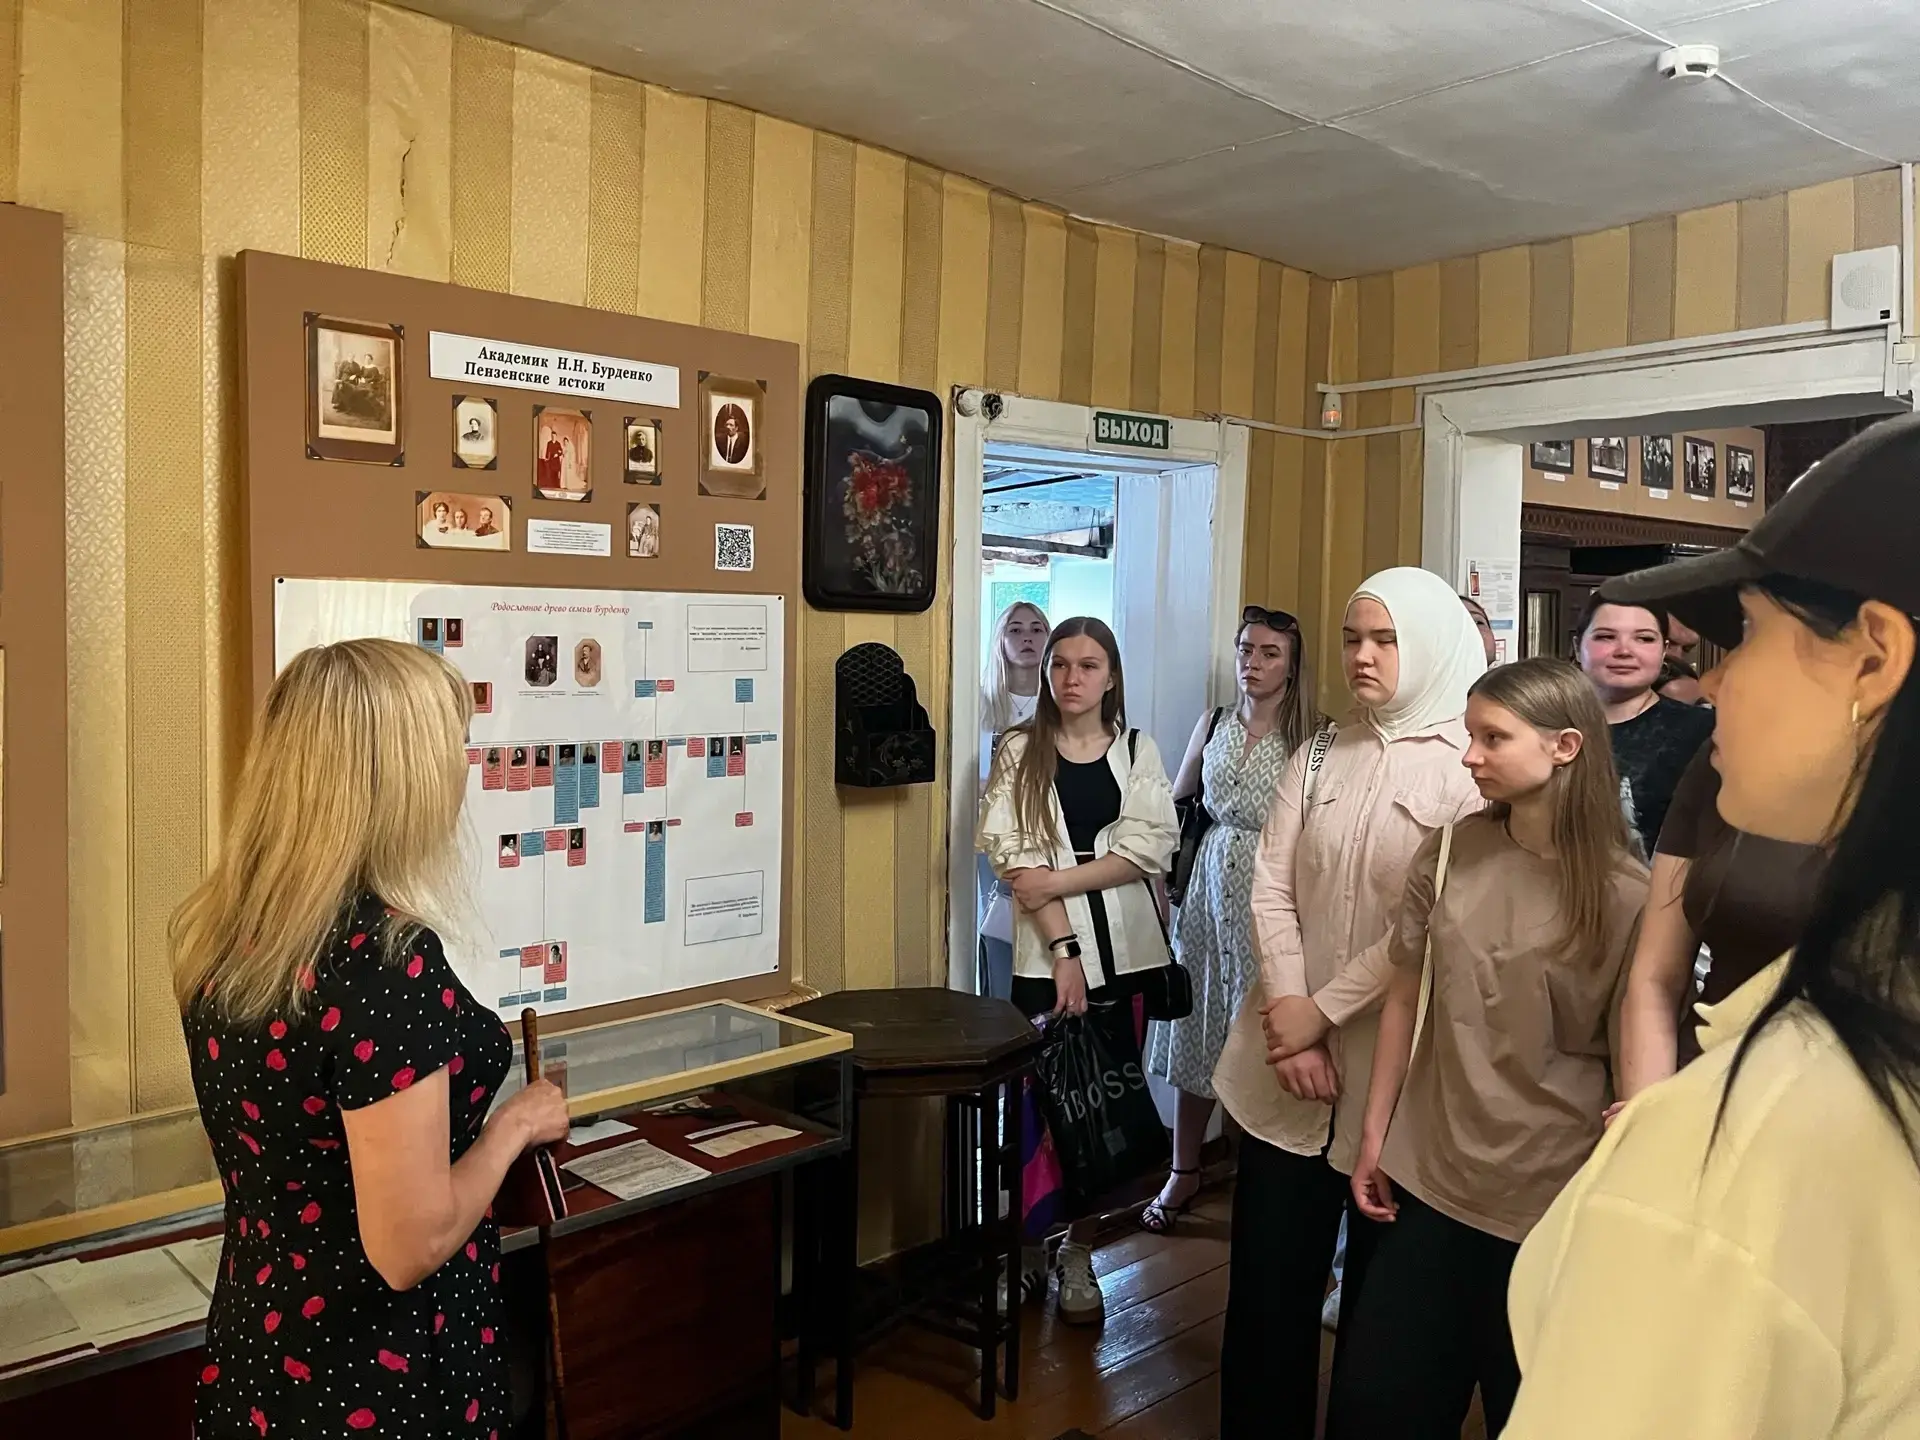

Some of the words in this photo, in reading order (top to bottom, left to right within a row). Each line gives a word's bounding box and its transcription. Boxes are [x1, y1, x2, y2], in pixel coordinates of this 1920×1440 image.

[464, 361, 550, 385] Пензенские
[558, 375, 605, 392] истоки
[477, 346, 549, 368] Академик
[557, 356, 588, 373] Н.Н.
[592, 361, 653, 383] Бурденко
[1098, 417, 1164, 447] ВЫХОД
[491, 601, 542, 612] Родословное
[544, 602, 567, 615] древо
[568, 605, 592, 613] семьи
[593, 603, 630, 616] Бурденко
[1310, 732, 1331, 772] GUESS
